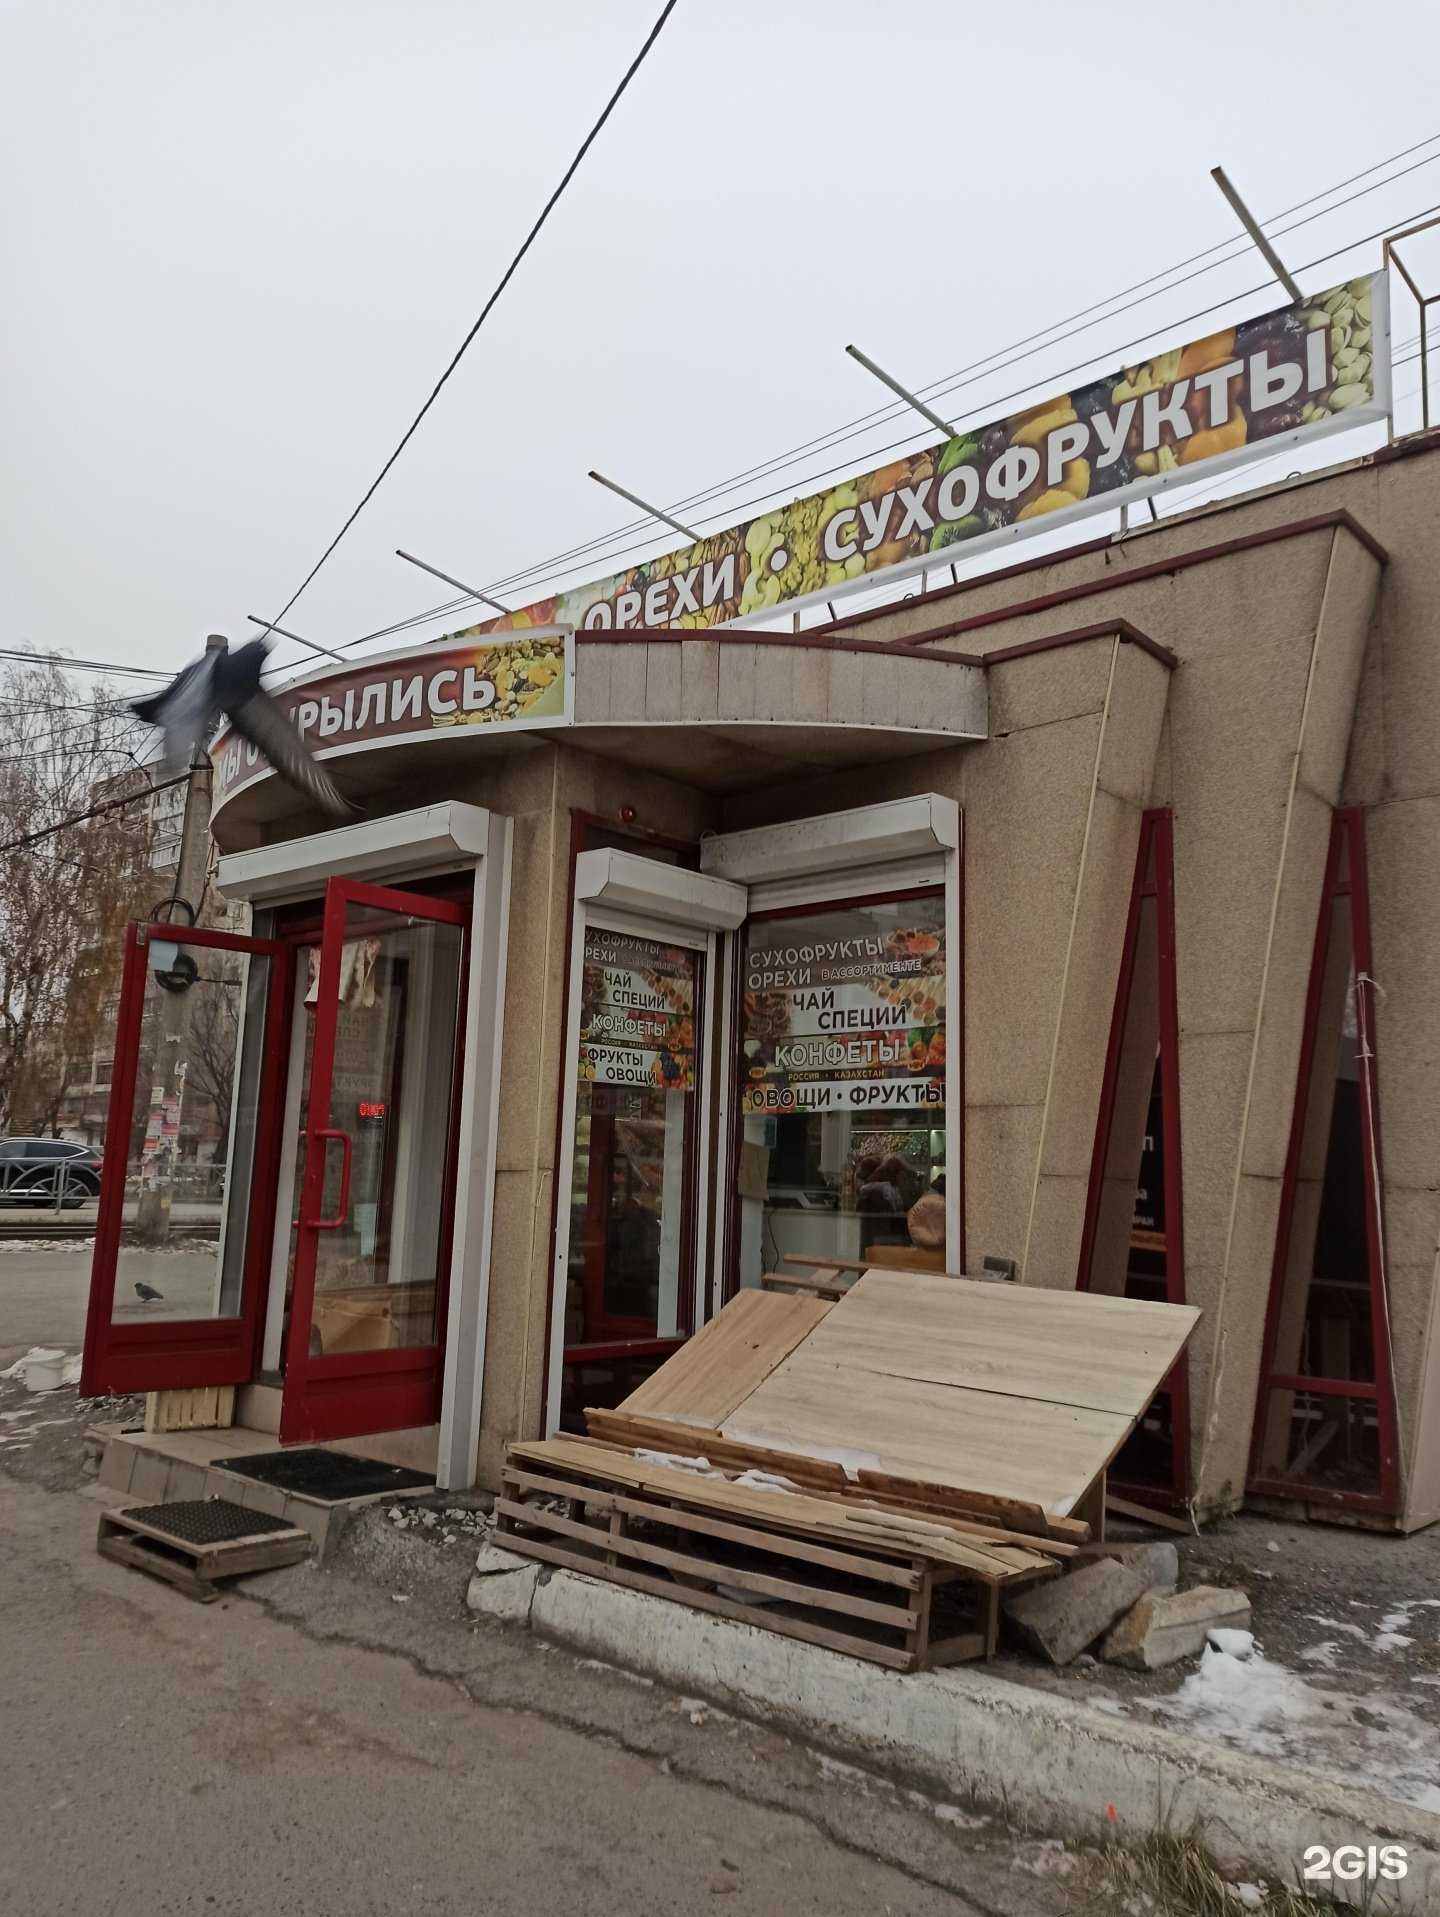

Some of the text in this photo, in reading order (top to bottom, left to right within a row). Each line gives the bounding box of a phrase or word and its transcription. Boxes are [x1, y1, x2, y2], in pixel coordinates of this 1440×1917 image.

[585, 329, 1329, 629] ОРЕХИ СУХОФРУКТЫ
[246, 666, 497, 767] ОРЫЛИСЬ
[585, 928, 660, 956] УХОФРУКТЫ
[749, 936, 884, 968] СУХОФРУКТЫ
[585, 946, 617, 963] РЕХИ
[604, 972, 632, 988] ЧАЙ
[748, 968, 811, 989] ОРЕХИ
[792, 987, 835, 1011] ЧАЙ
[591, 1013, 667, 1038] КОНФЕТЫ
[587, 1047, 644, 1067] ФРУКТЫ
[774, 1038, 901, 1069] КОНФЕТЫ
[605, 1067, 657, 1086] ОВОЩИ
[788, 1069, 886, 1081] РОССИЯ КАЗАХСТАН
[751, 1082, 946, 1109] ОВОЩИ ФРУКТЫ
